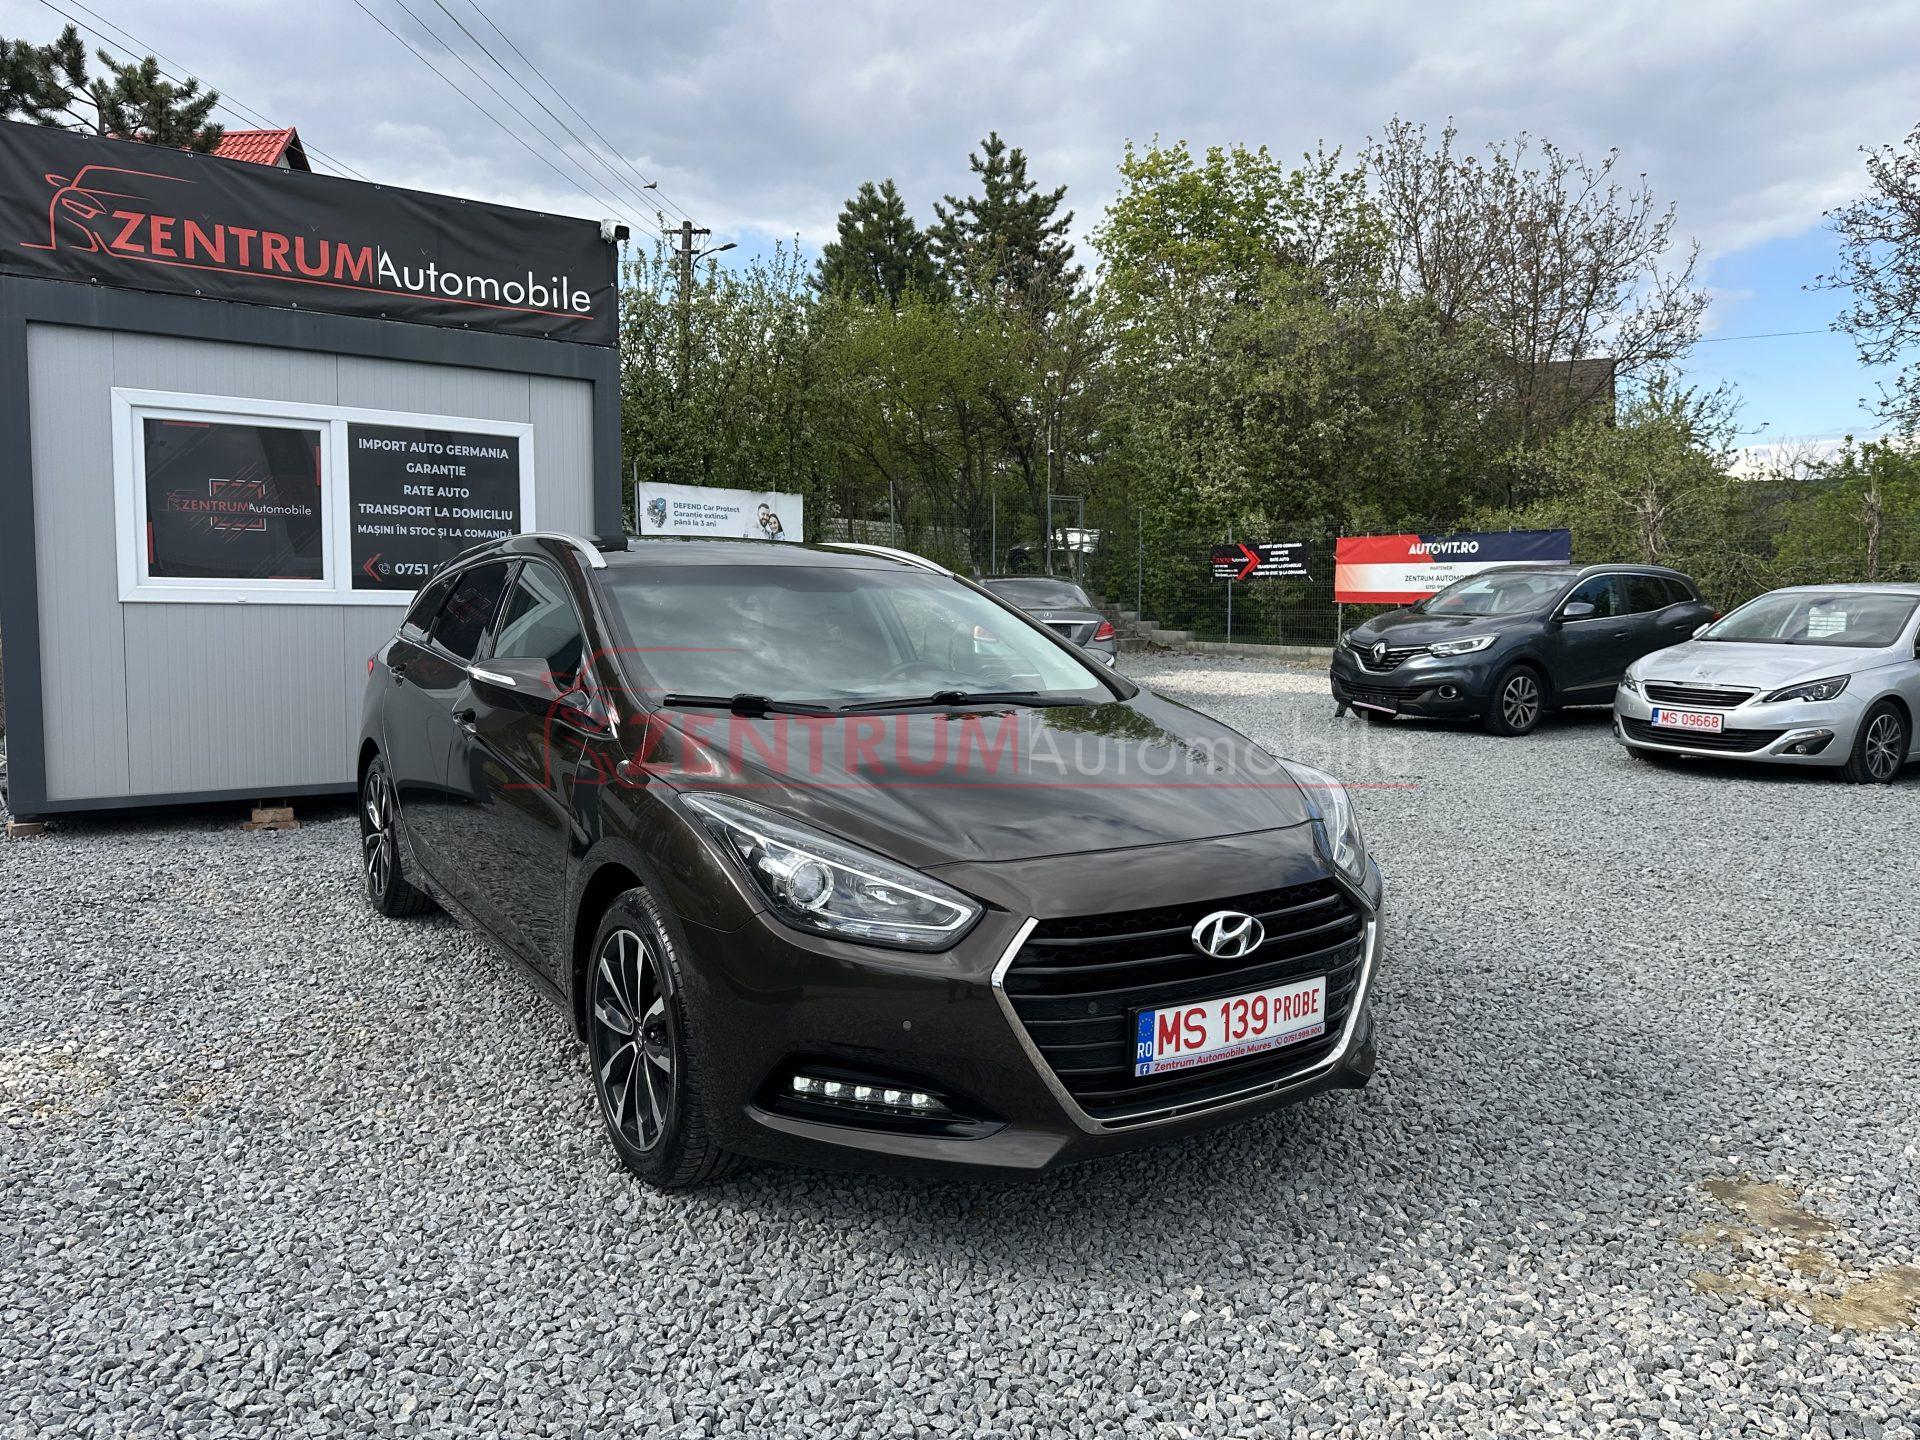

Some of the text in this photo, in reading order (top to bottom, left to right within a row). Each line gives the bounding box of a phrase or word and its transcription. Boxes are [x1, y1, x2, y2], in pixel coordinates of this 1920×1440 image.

[110, 210, 592, 313] ZENTRUM Automobile
[358, 438, 509, 459] IMPORT AUTO GERMANIA
[406, 463, 467, 478] GARANȚIE
[403, 485, 470, 498] RATE AUTO
[182, 500, 312, 516] ZENTRUM Automobile
[358, 503, 513, 521] TRANSPORT LA DOMICILIU
[673, 502, 702, 510] DEFEND
[716, 505, 740, 513] Protect
[357, 523, 513, 539] MAȘINI ÎN STOC ȘI LA COMANDĂ
[1408, 541, 1479, 555] AUTOVIT.RO
[394, 563, 429, 575] 0751
[1662, 711, 1678, 724] MS
[1681, 713, 1719, 728] 09668
[1158, 988, 1320, 1056] MS 139 PROBE
[1137, 1041, 1153, 1059] RO
[1154, 1058, 1195, 1072] Zentrum
[1196, 1047, 1245, 1064] Automobile
[1247, 1041, 1272, 1054] Mures
